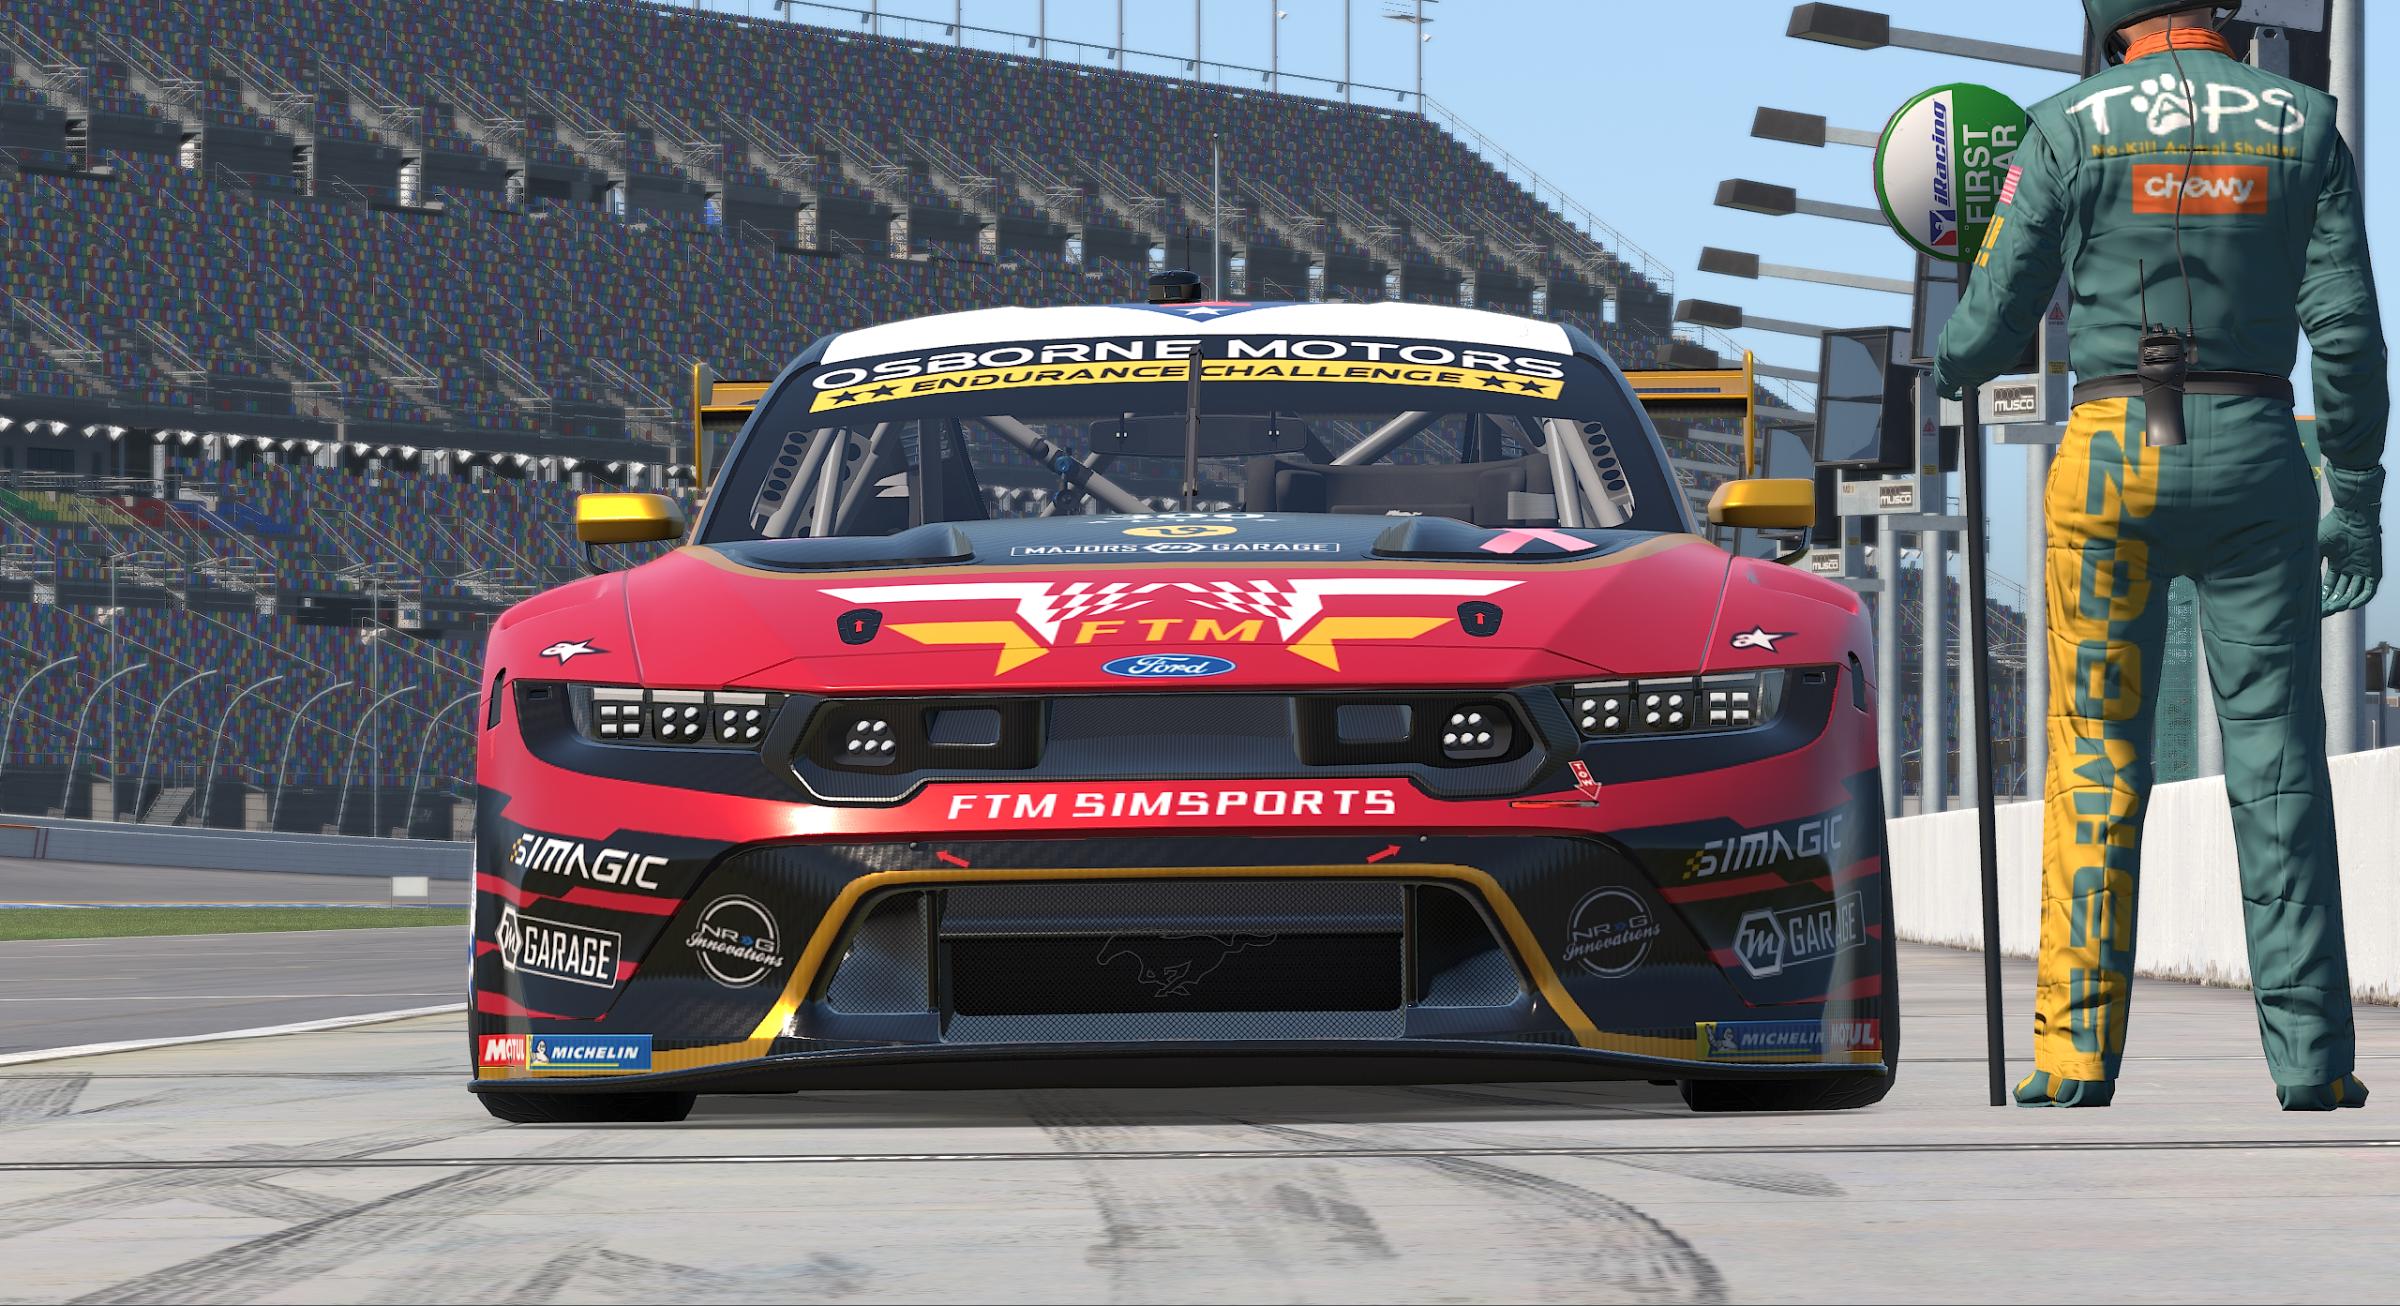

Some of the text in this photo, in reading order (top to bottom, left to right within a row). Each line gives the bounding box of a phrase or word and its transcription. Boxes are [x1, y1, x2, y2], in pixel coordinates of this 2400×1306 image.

[2066, 73, 2305, 135] TAPS
[1932, 100, 1950, 208] iRacing
[2091, 141, 2158, 157] No-Kill
[2234, 140, 2298, 158] Shelter
[1963, 124, 1991, 224] FIRST
[2144, 173, 2254, 204] chewy
[811, 339, 1565, 390] OSBORNE MOTORS
[910, 364, 1464, 393] ENDURANCE CHALLENGE
[1024, 542, 1329, 555] MAJORS GARAGE
[1074, 619, 1264, 644] FTM
[1128, 656, 1210, 674] Ford
[1573, 763, 1593, 787] TOW
[947, 790, 1397, 819] FTM SIMSPORTS
[510, 833, 669, 890] SIMAGIC
[1684, 814, 1842, 879] SIMAGIC
[1563, 922, 1661, 961] Innovations
[1788, 902, 1855, 954] GARAGE
[524, 926, 612, 979] GARAGE
[686, 932, 784, 968] Innovations
[1741, 1031, 1824, 1045] MICHELIN
[1831, 1023, 1874, 1045] MOTUL
[484, 1038, 525, 1062] MOTUL
[551, 1045, 639, 1060] MICHELIN
